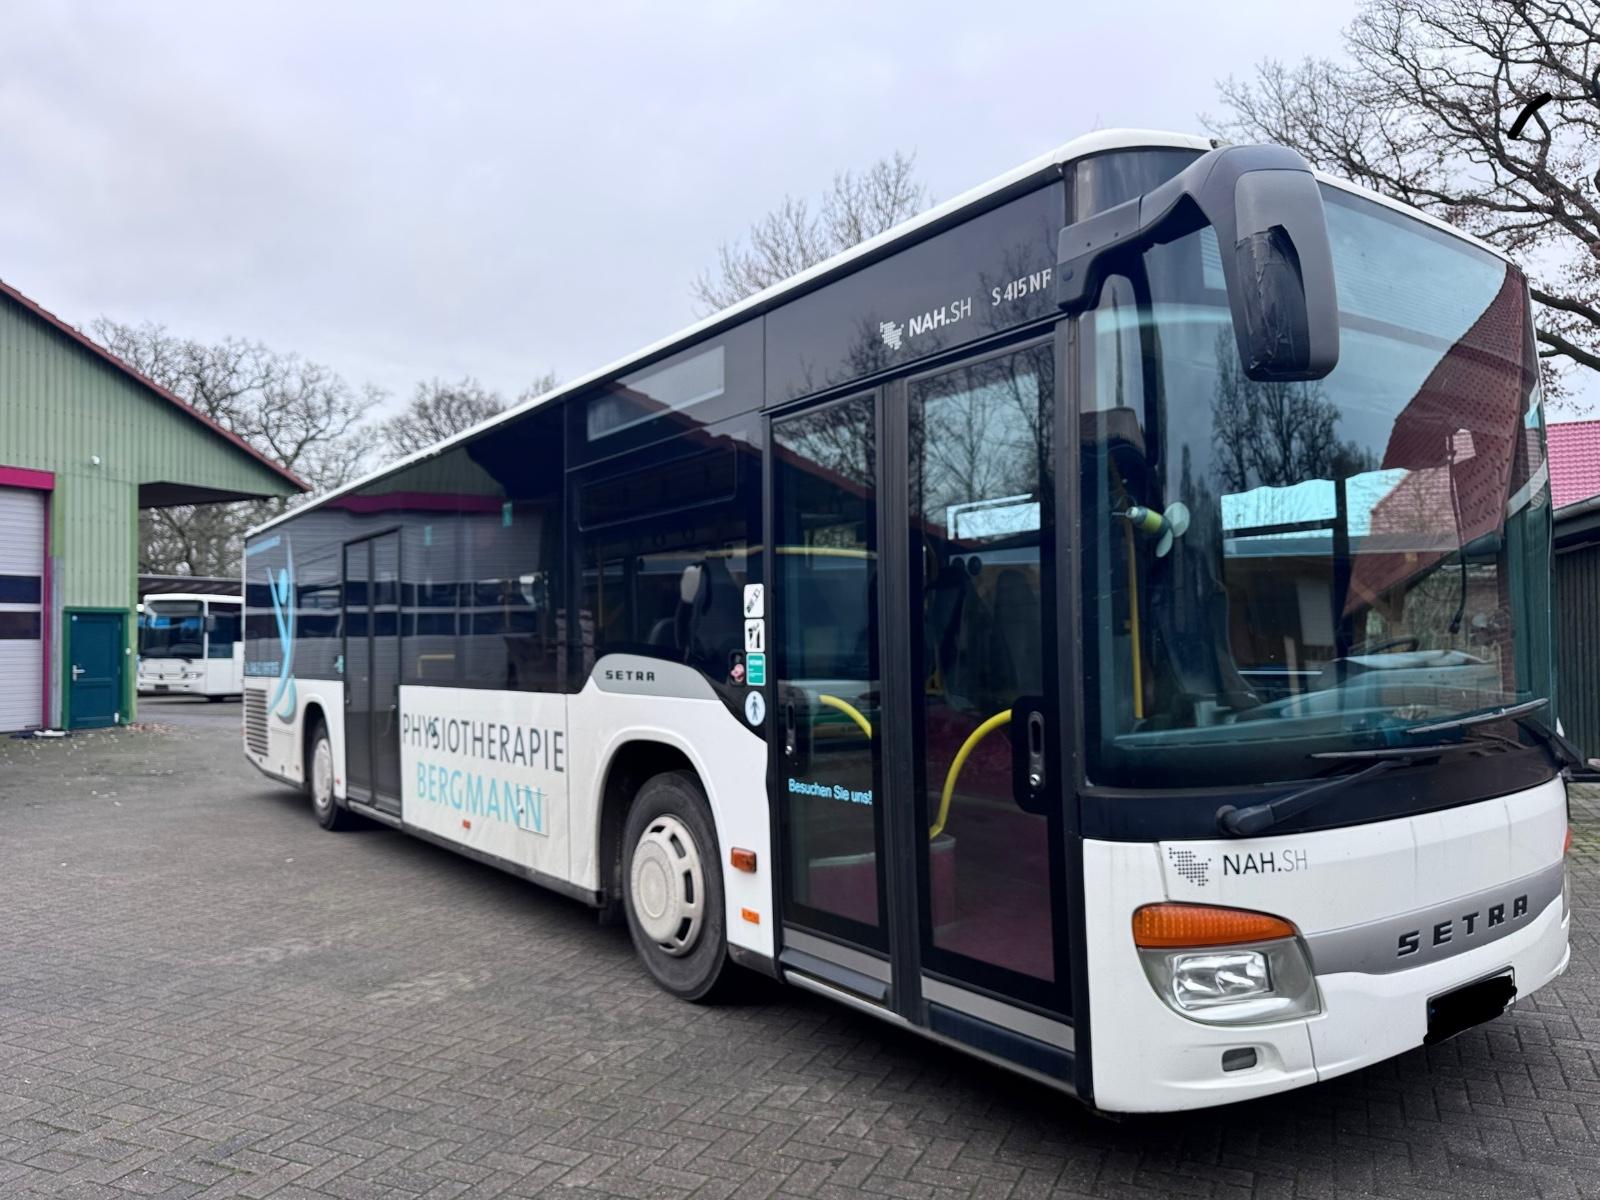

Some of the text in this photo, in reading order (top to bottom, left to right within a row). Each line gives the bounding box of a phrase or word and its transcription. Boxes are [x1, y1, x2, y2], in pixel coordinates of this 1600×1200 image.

[992, 268, 1052, 306] S 415 NF
[908, 297, 972, 337] NAH.SH
[605, 669, 655, 681] SETRA
[403, 713, 565, 773] PHYSIOTHERAPIE
[417, 761, 543, 833] BERGMANN
[788, 778, 873, 805] Besuchen Sie uns!
[1223, 849, 1308, 876] NAH.SH
[1397, 894, 1528, 957] SETRA
